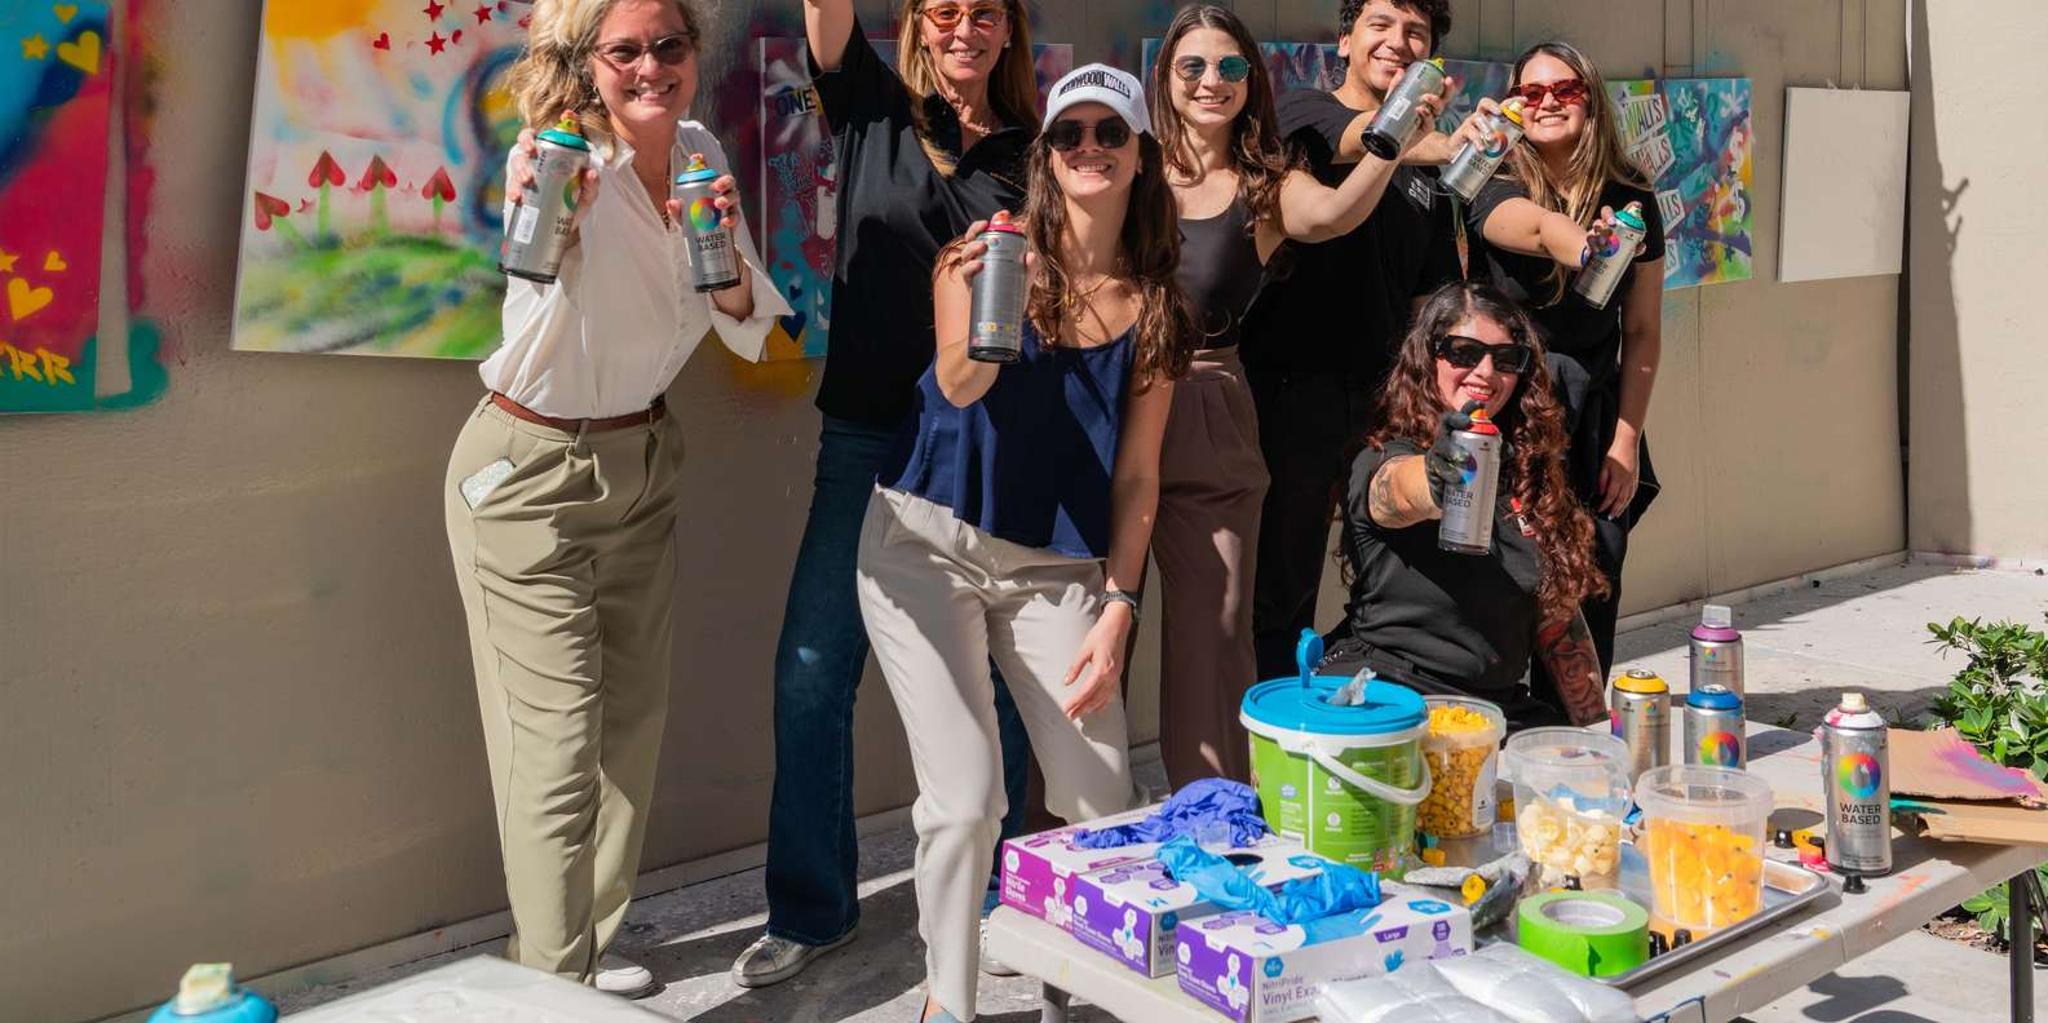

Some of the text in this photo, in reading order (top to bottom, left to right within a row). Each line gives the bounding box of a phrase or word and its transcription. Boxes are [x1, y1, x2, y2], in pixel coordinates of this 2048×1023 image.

[696, 232, 725, 244] WATER
[697, 241, 726, 252] BASED
[1840, 804, 1881, 815] WATER
[1841, 814, 1880, 825] BASED
[1384, 931, 1401, 941] Large
[1264, 988, 1291, 1006] Vinyl
